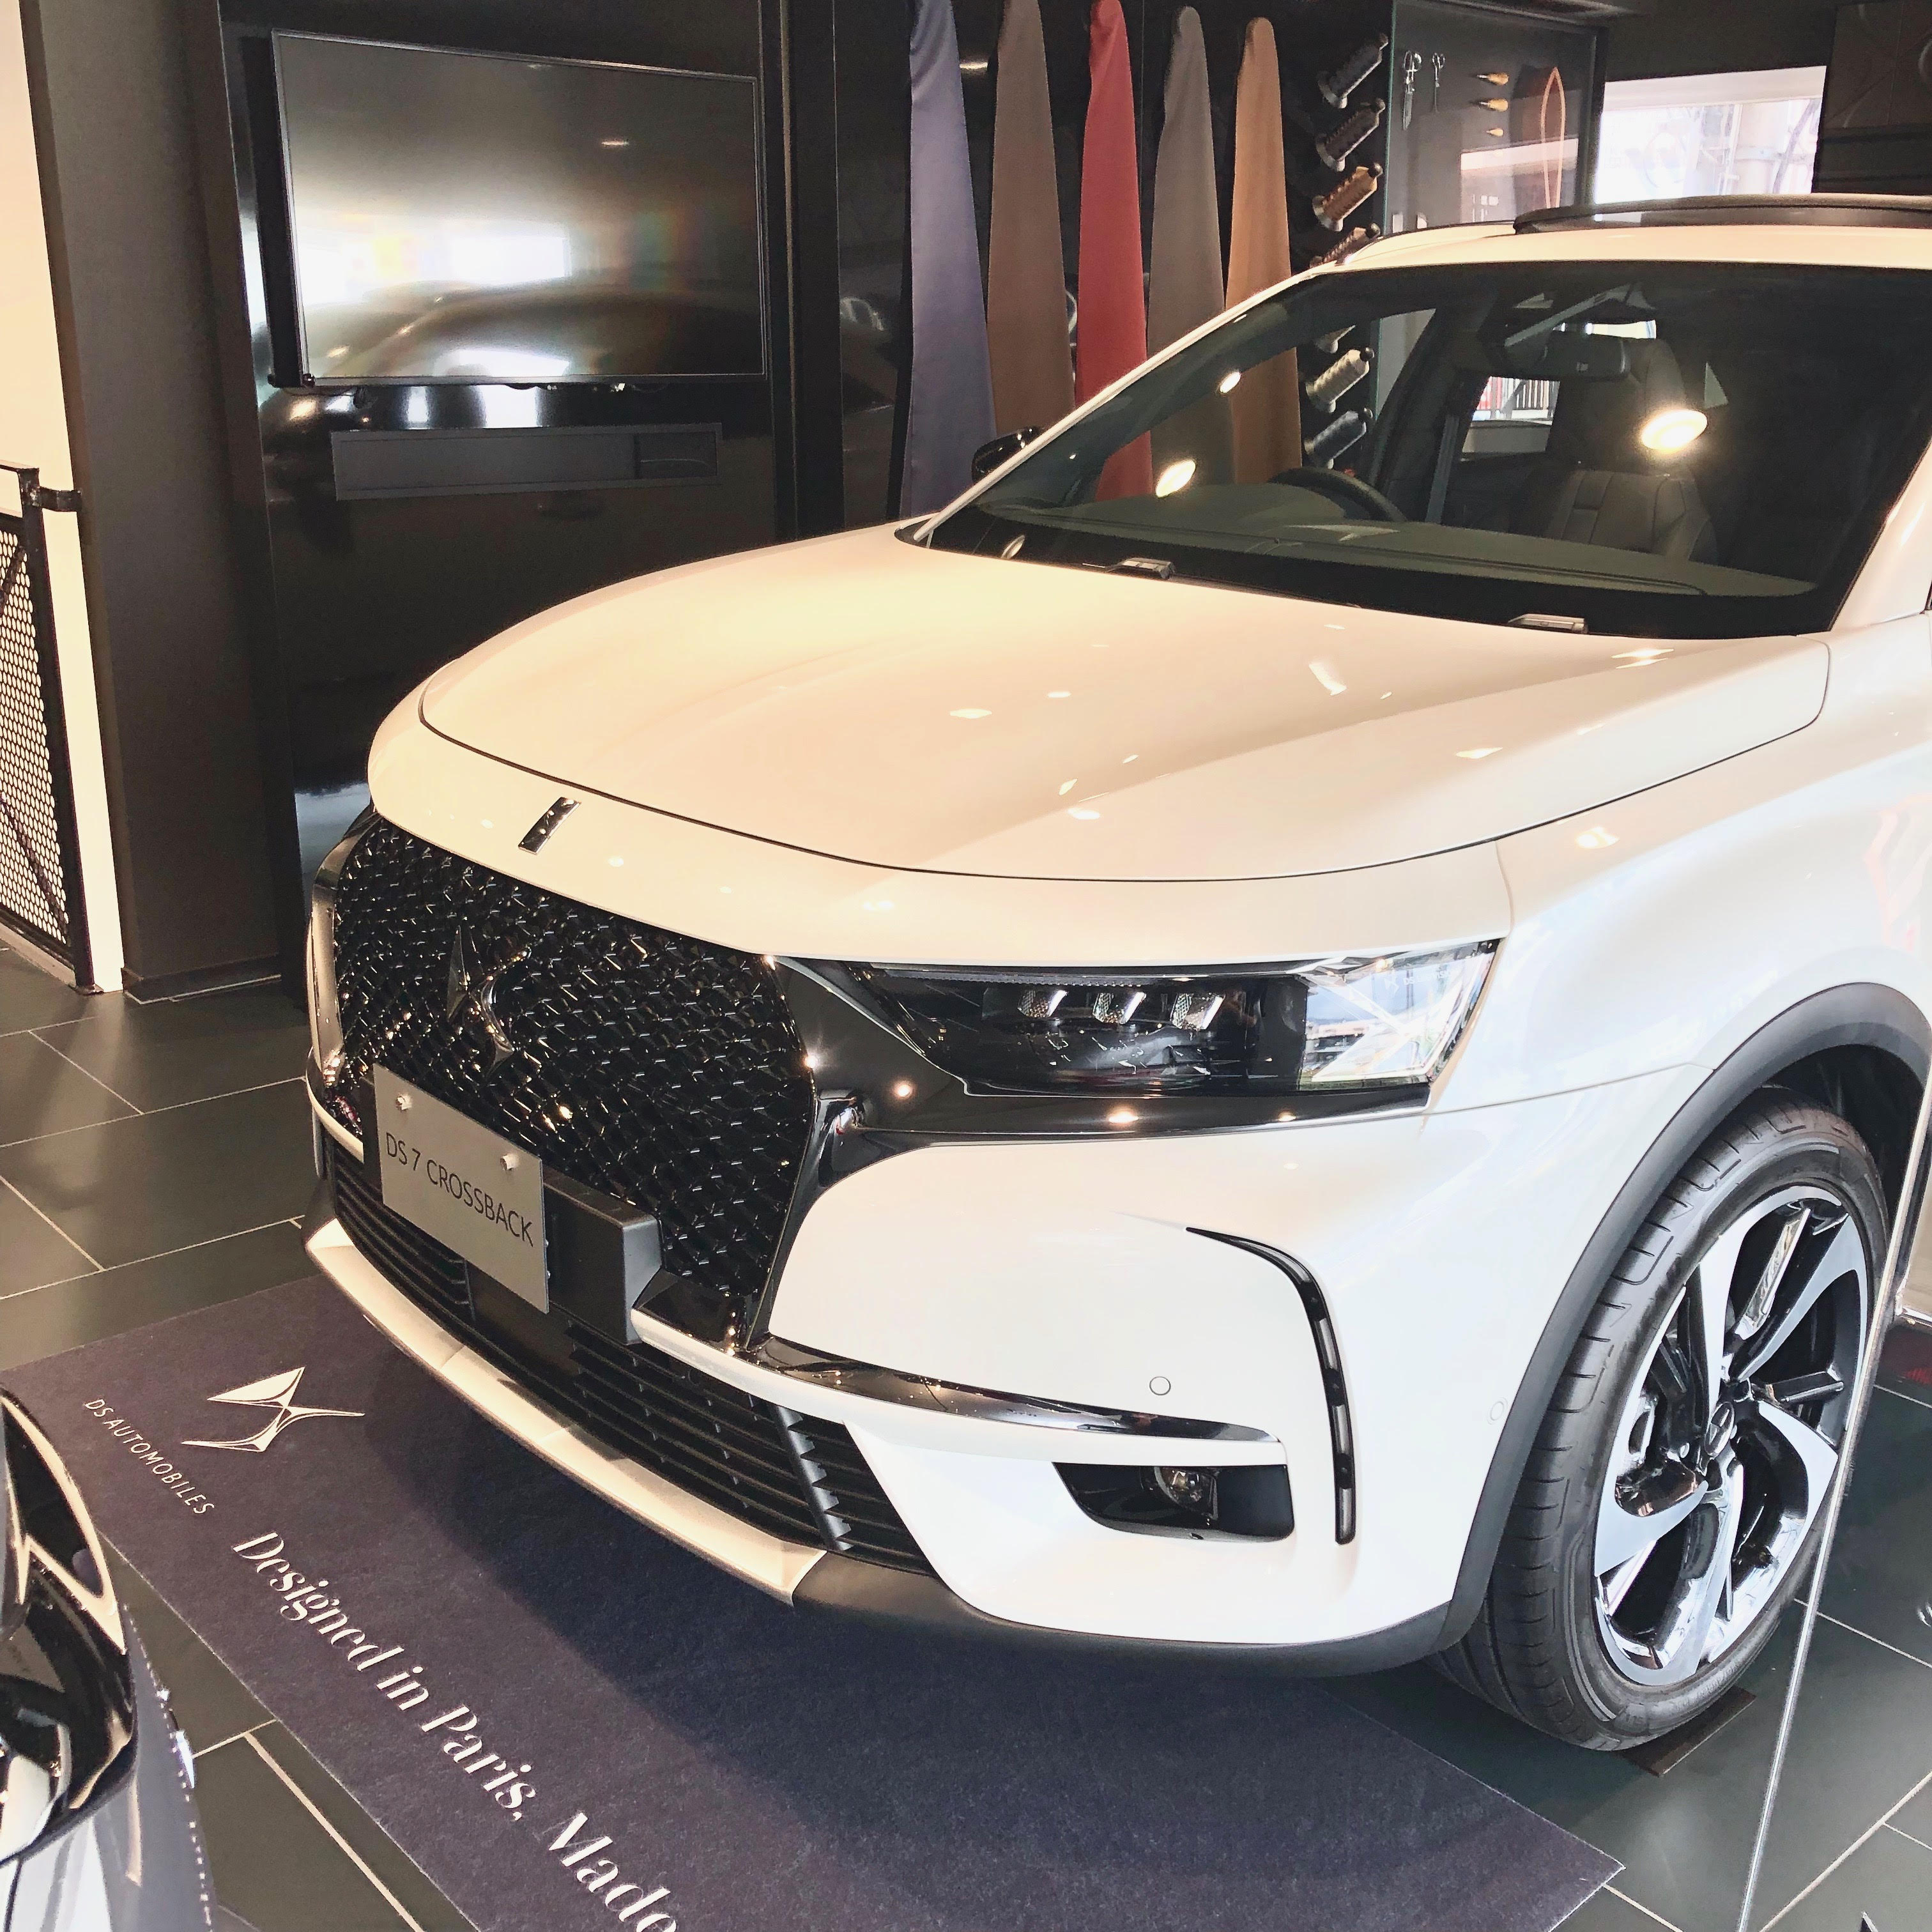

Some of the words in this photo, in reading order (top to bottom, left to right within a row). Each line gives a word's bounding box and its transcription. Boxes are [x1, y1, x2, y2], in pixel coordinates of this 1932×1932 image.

[386, 1132, 408, 1165] DS
[412, 1148, 421, 1171] 7
[426, 1159, 533, 1248] CROSSBACK
[84, 1399, 114, 1418] DS
[103, 1418, 215, 1514] AUTOMOBILES
[233, 1532, 404, 1671] Designed
[376, 1666, 429, 1711] in
[533, 1812, 677, 1932] Made
